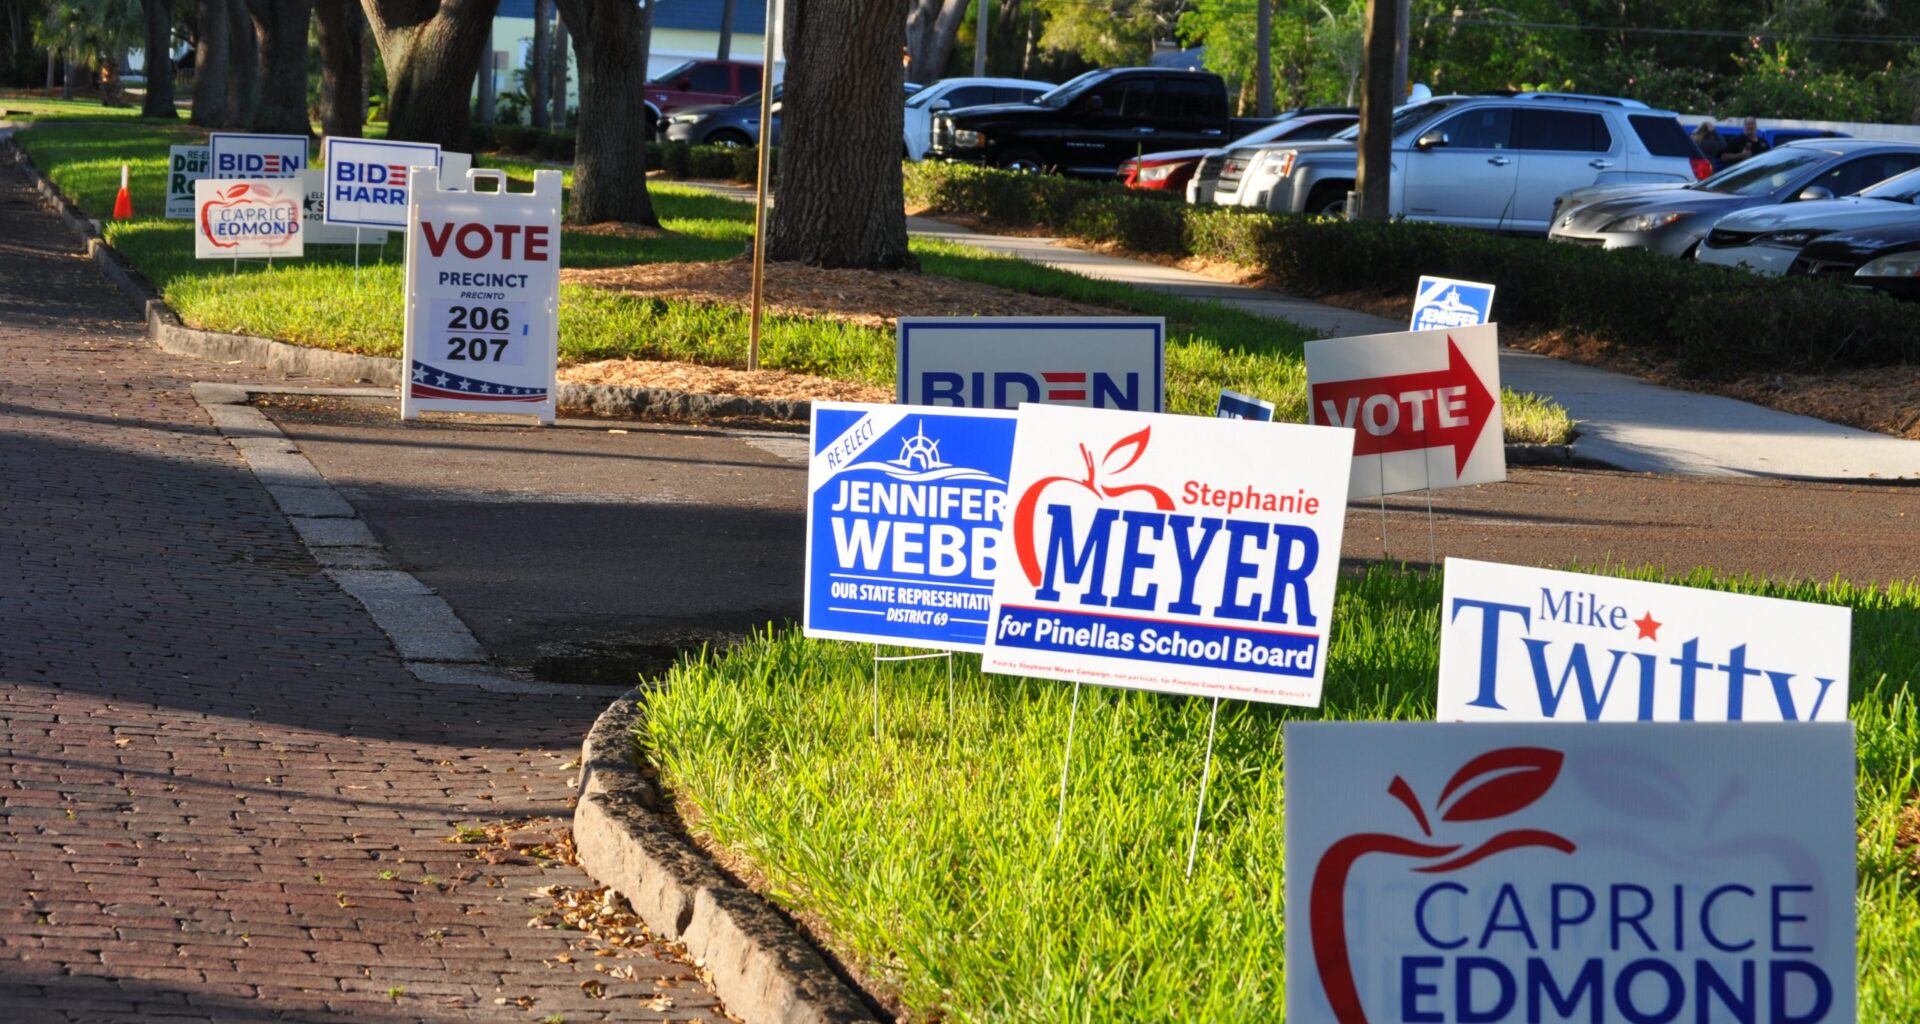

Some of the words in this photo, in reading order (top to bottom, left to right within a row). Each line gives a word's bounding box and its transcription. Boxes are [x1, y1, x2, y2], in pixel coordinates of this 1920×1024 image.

[174, 154, 210, 173] Dar
[219, 153, 299, 172] BIDEN
[336, 185, 409, 205] HARR
[217, 221, 299, 236] EDMOND
[221, 208, 297, 221] CAPRICE
[421, 221, 549, 261] VOTE
[439, 271, 528, 288] PRECINCT
[460, 291, 505, 300] PRECINTO
[448, 306, 510, 331] 206
[447, 337, 509, 362] 207
[921, 372, 1139, 411] BIDEN
[1320, 385, 1470, 436] VOTE
[827, 419, 876, 470] RE-ELECT
[831, 480, 1007, 522] JENNIFER
[1181, 480, 1320, 515] Stephanie
[831, 516, 1002, 580] WEBB
[1035, 503, 1320, 627] MEYER
[831, 582, 858, 600] OUR
[859, 585, 896, 603] STATE
[1538, 588, 1628, 631] Mike
[886, 607, 932, 625] DISTRICT
[934, 612, 948, 626] 69
[998, 614, 1031, 640] for
[1035, 618, 1135, 652] Pinellas
[1138, 628, 1230, 663] School
[1234, 637, 1316, 671] Board
[1414, 881, 1815, 953] CAPRICE
[1401, 956, 1833, 1024] EDMOND
